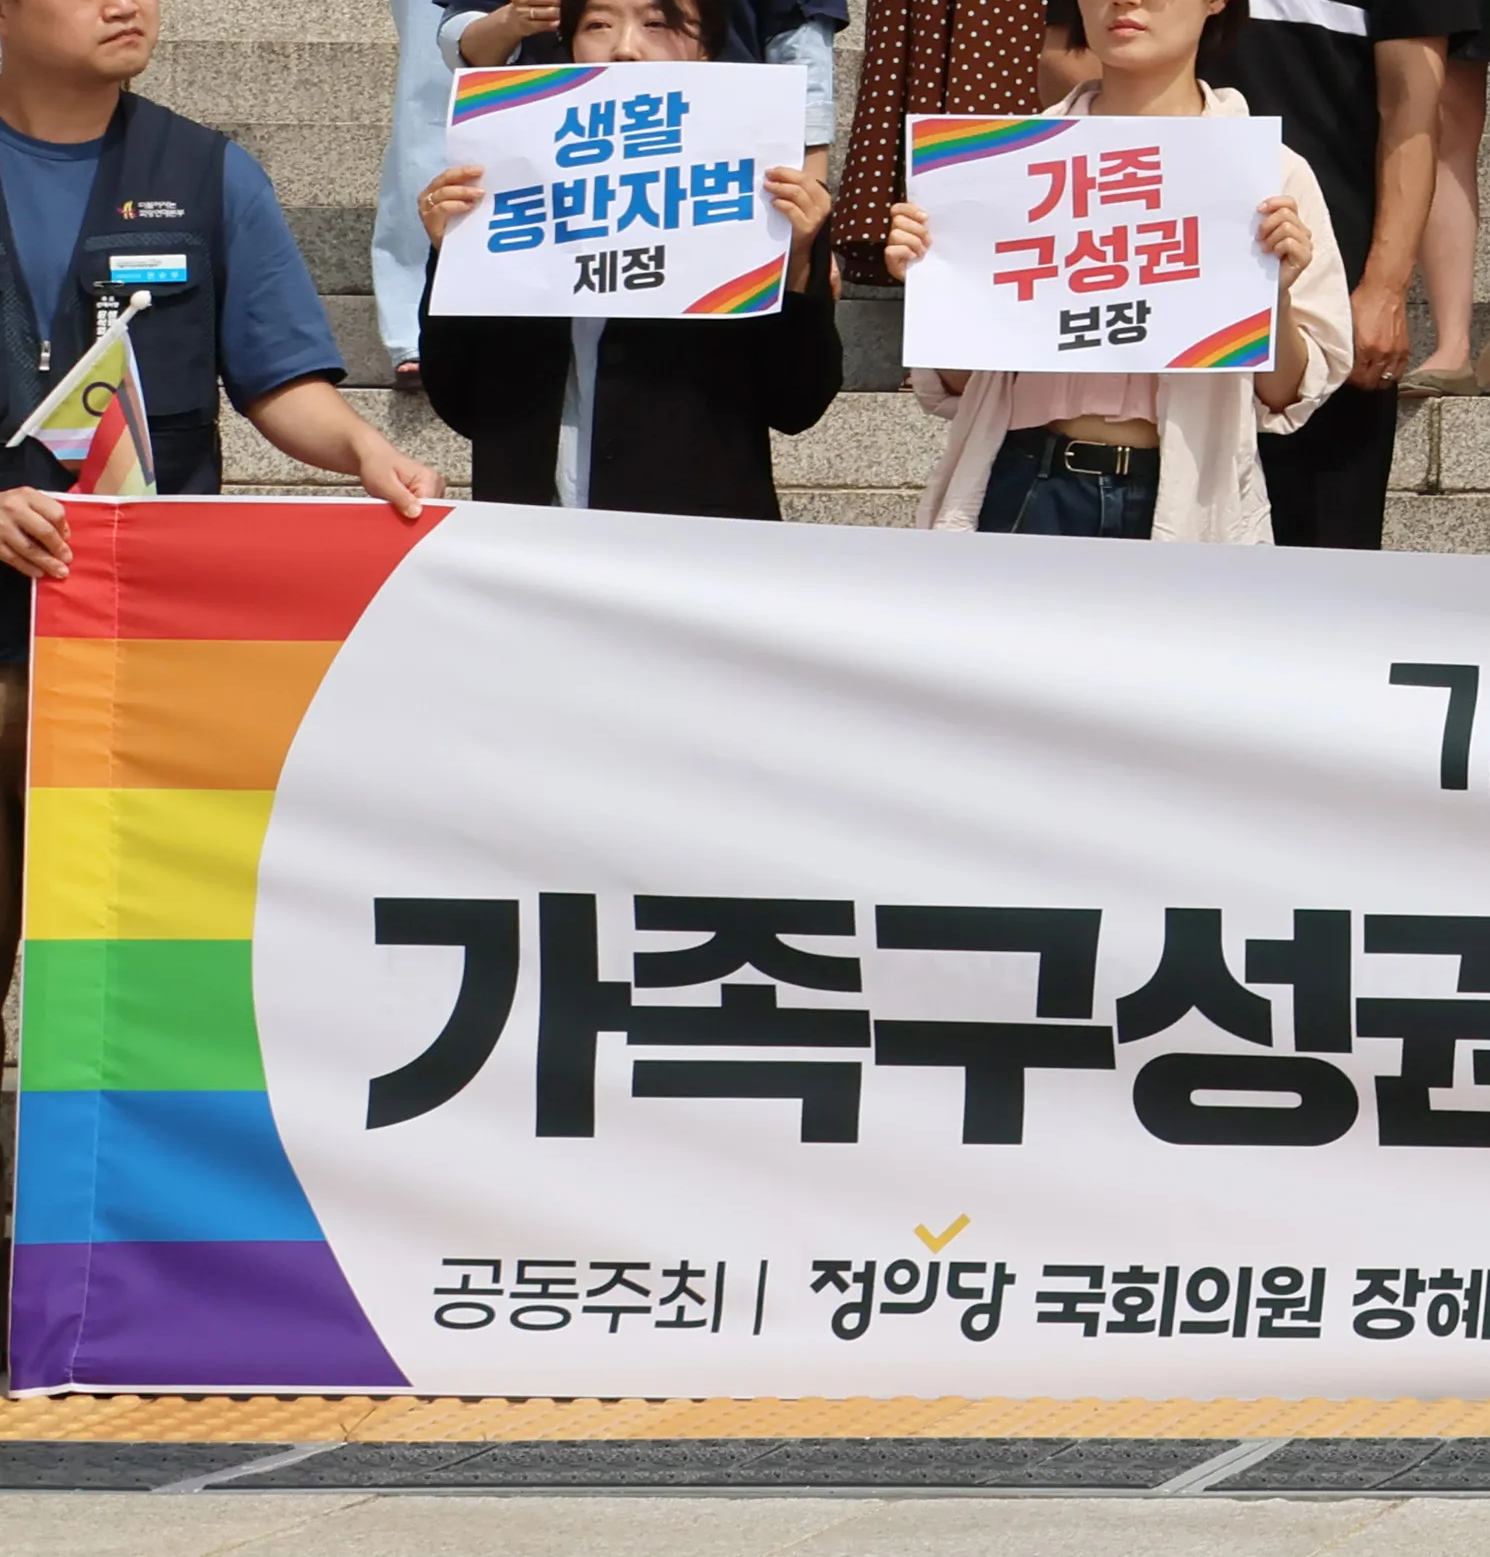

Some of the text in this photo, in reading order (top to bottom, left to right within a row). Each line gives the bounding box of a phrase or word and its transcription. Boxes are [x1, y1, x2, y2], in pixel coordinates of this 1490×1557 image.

[547, 84, 696, 173] 생활
[486, 158, 756, 253] 동반자법
[1025, 146, 1163, 223] 가족
[575, 246, 664, 292] 제정
[994, 215, 1201, 301] 구성권
[1059, 301, 1150, 350] 보장
[435, 1259, 725, 1332] 공동주최
[811, 1260, 1015, 1341] 정의당
[1036, 1265, 1325, 1338] 국회의원
